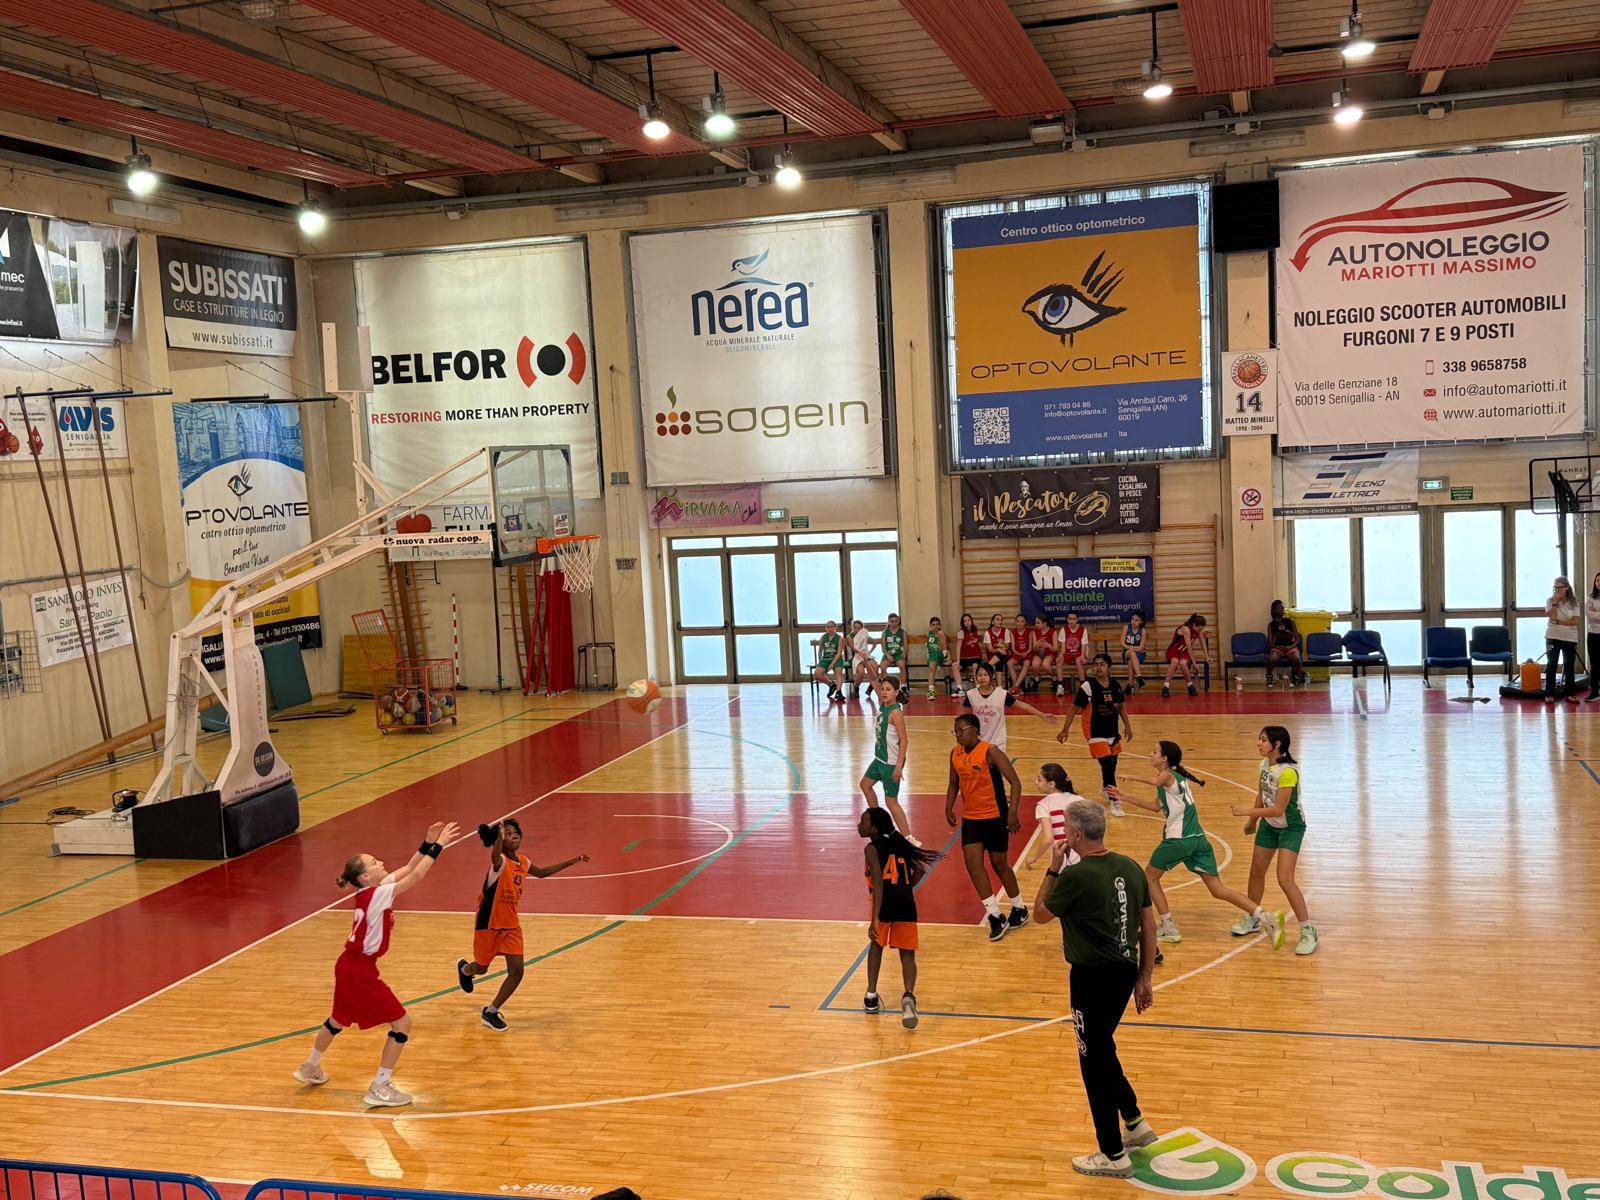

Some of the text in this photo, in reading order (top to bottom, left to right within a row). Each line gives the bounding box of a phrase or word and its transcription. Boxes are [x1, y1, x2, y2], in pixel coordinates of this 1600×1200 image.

[1000, 214, 1146, 238] Centro ottico optometrico
[1328, 230, 1550, 266] AUTONOLEGGIO
[1341, 255, 1537, 282] MARIOTTI MASSIMO
[168, 260, 284, 306] SUBISSATI
[173, 298, 285, 323] CASE E STRUTTURE IN LEGNO
[691, 281, 809, 336] nerea
[1293, 294, 1566, 328] NOLEGGIO SCOOTER AUTOMOBILI
[192, 331, 273, 348] www.subissati.it
[705, 333, 795, 346] ACQUA MINERALE NATURALE
[1343, 322, 1515, 348] FURGONI 7 E 9 POSTI
[371, 348, 508, 386] BELFOR
[970, 350, 1187, 379] OPTOVOLANTE
[1442, 357, 1528, 374] 338 9658758
[1294, 376, 1399, 392] Via delle Genziane 18
[1442, 379, 1568, 398] info@automariotti.it
[1117, 398, 1128, 406] Via
[1157, 394, 1177, 403] Caro,
[1235, 391, 1264, 414] 14
[1295, 390, 1400, 406] 60019 Senigallia AN
[371, 403, 589, 424] RESTORING MORE THAN PROPERTY
[1044, 403, 1056, 411] 071
[1118, 404, 1168, 415] Senigallia (AN)
[1442, 402, 1567, 420] www.automariotti.it
[695, 400, 869, 438] sogein
[1118, 413, 1140, 421] 60019
[1224, 415, 1275, 425] MATTEO MINELLI
[66, 433, 111, 441] SENIGAIA
[1045, 431, 1109, 442] www.optovolante.it
[1118, 475, 1138, 483] CUCINA
[1118, 482, 1148, 490] CASALINGA
[1125, 489, 1142, 497] PESCE
[973, 490, 1080, 523] il Pescatore
[1119, 510, 1136, 518] TUTTO
[396, 535, 482, 545] nuova radar coop.
[1044, 590, 1105, 603] ambiente
[1044, 600, 1142, 612] servizi ecologici integrati
[523, 1182, 595, 1195] SEICOM
